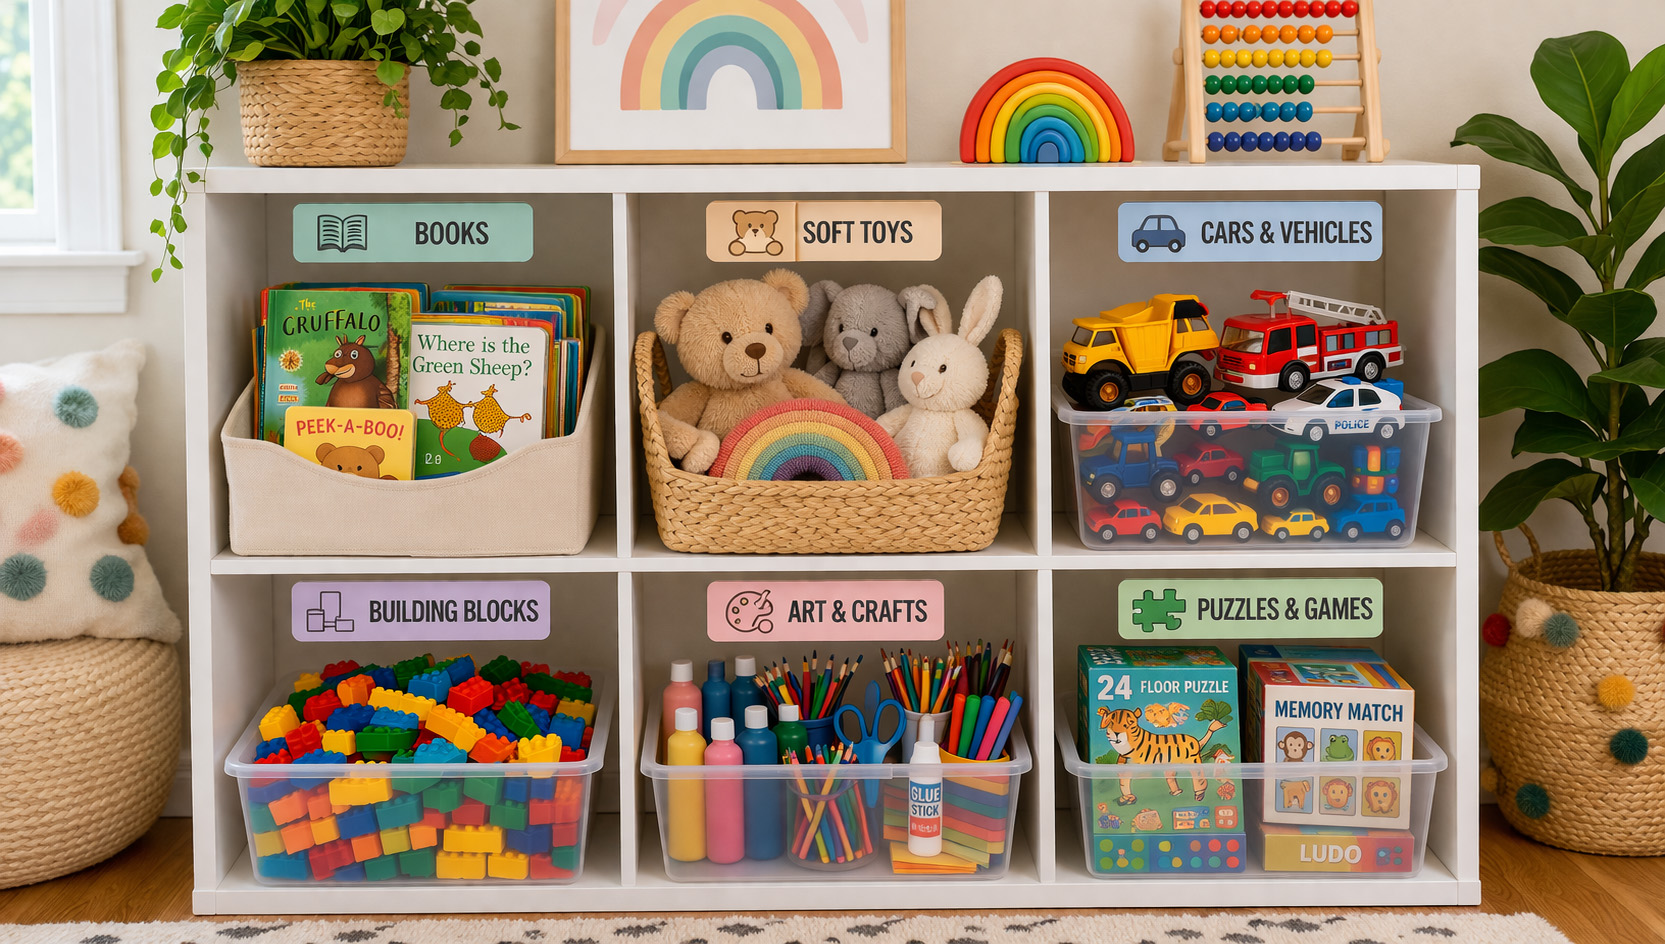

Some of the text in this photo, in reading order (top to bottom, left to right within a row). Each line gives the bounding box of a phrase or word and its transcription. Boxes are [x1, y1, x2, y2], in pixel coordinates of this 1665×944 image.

[415, 221, 489, 245] BOOKS
[803, 220, 913, 244] SOFT TOYS
[1201, 220, 1373, 244] CARS & VEHICLES
[282, 309, 380, 336] GRUFFALO
[418, 334, 530, 354] Where is the
[412, 356, 532, 381] Green Sheep?
[296, 417, 405, 441] PEEK-A-BOO!
[369, 599, 539, 623] BUILDING BLOCKS
[788, 599, 928, 623] ART & CRAFTS
[1198, 596, 1373, 621] PUZZLES & GAMES
[1097, 674, 1229, 701] 24 FLOOR PUZZLE
[1275, 700, 1403, 722] MEMORY MATCH
[911, 786, 940, 802] GLUE
[911, 803, 939, 816] STICK
[1300, 844, 1362, 864] LUDO
